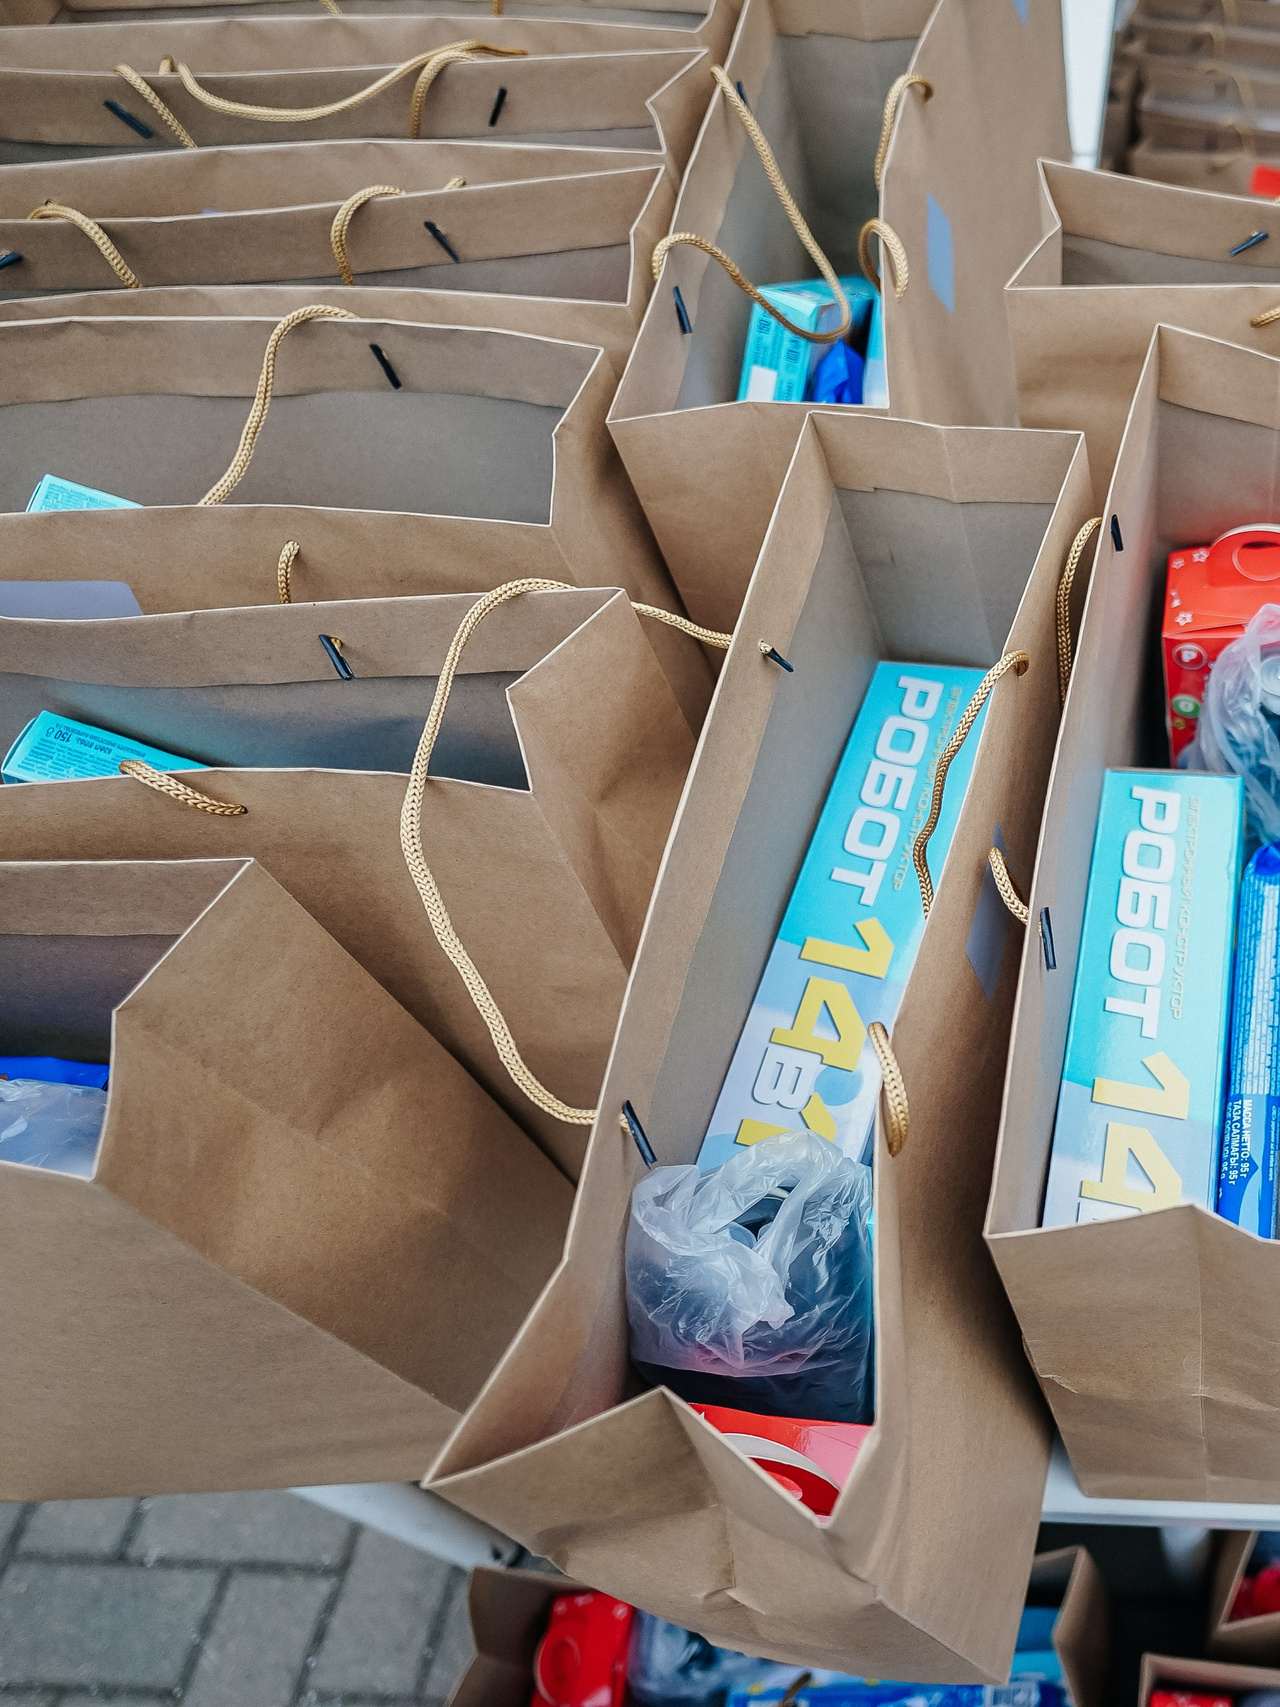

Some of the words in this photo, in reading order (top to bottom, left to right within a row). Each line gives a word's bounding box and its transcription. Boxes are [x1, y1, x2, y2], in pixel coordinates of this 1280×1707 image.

[54, 728, 72, 743] 150
[831, 675, 944, 907] РОБОТ
[1182, 797, 1201, 900] ЭЛЕКТРОННЫЙ
[1105, 785, 1181, 1039] РОБОТ
[1170, 903, 1191, 1020] КОНСТРУКТОР
[771, 916, 896, 1071] 14
[1081, 1051, 1190, 1211] 14
[1232, 1100, 1241, 1121] ТАЗА
[1242, 1100, 1252, 1129] МАССА
[1230, 1123, 1240, 1169] САЛМАҒЫ:
[1240, 1130, 1251, 1161] НЕТТО:
[1240, 1163, 1249, 1172] 95
[1229, 1170, 1238, 1180] 95
